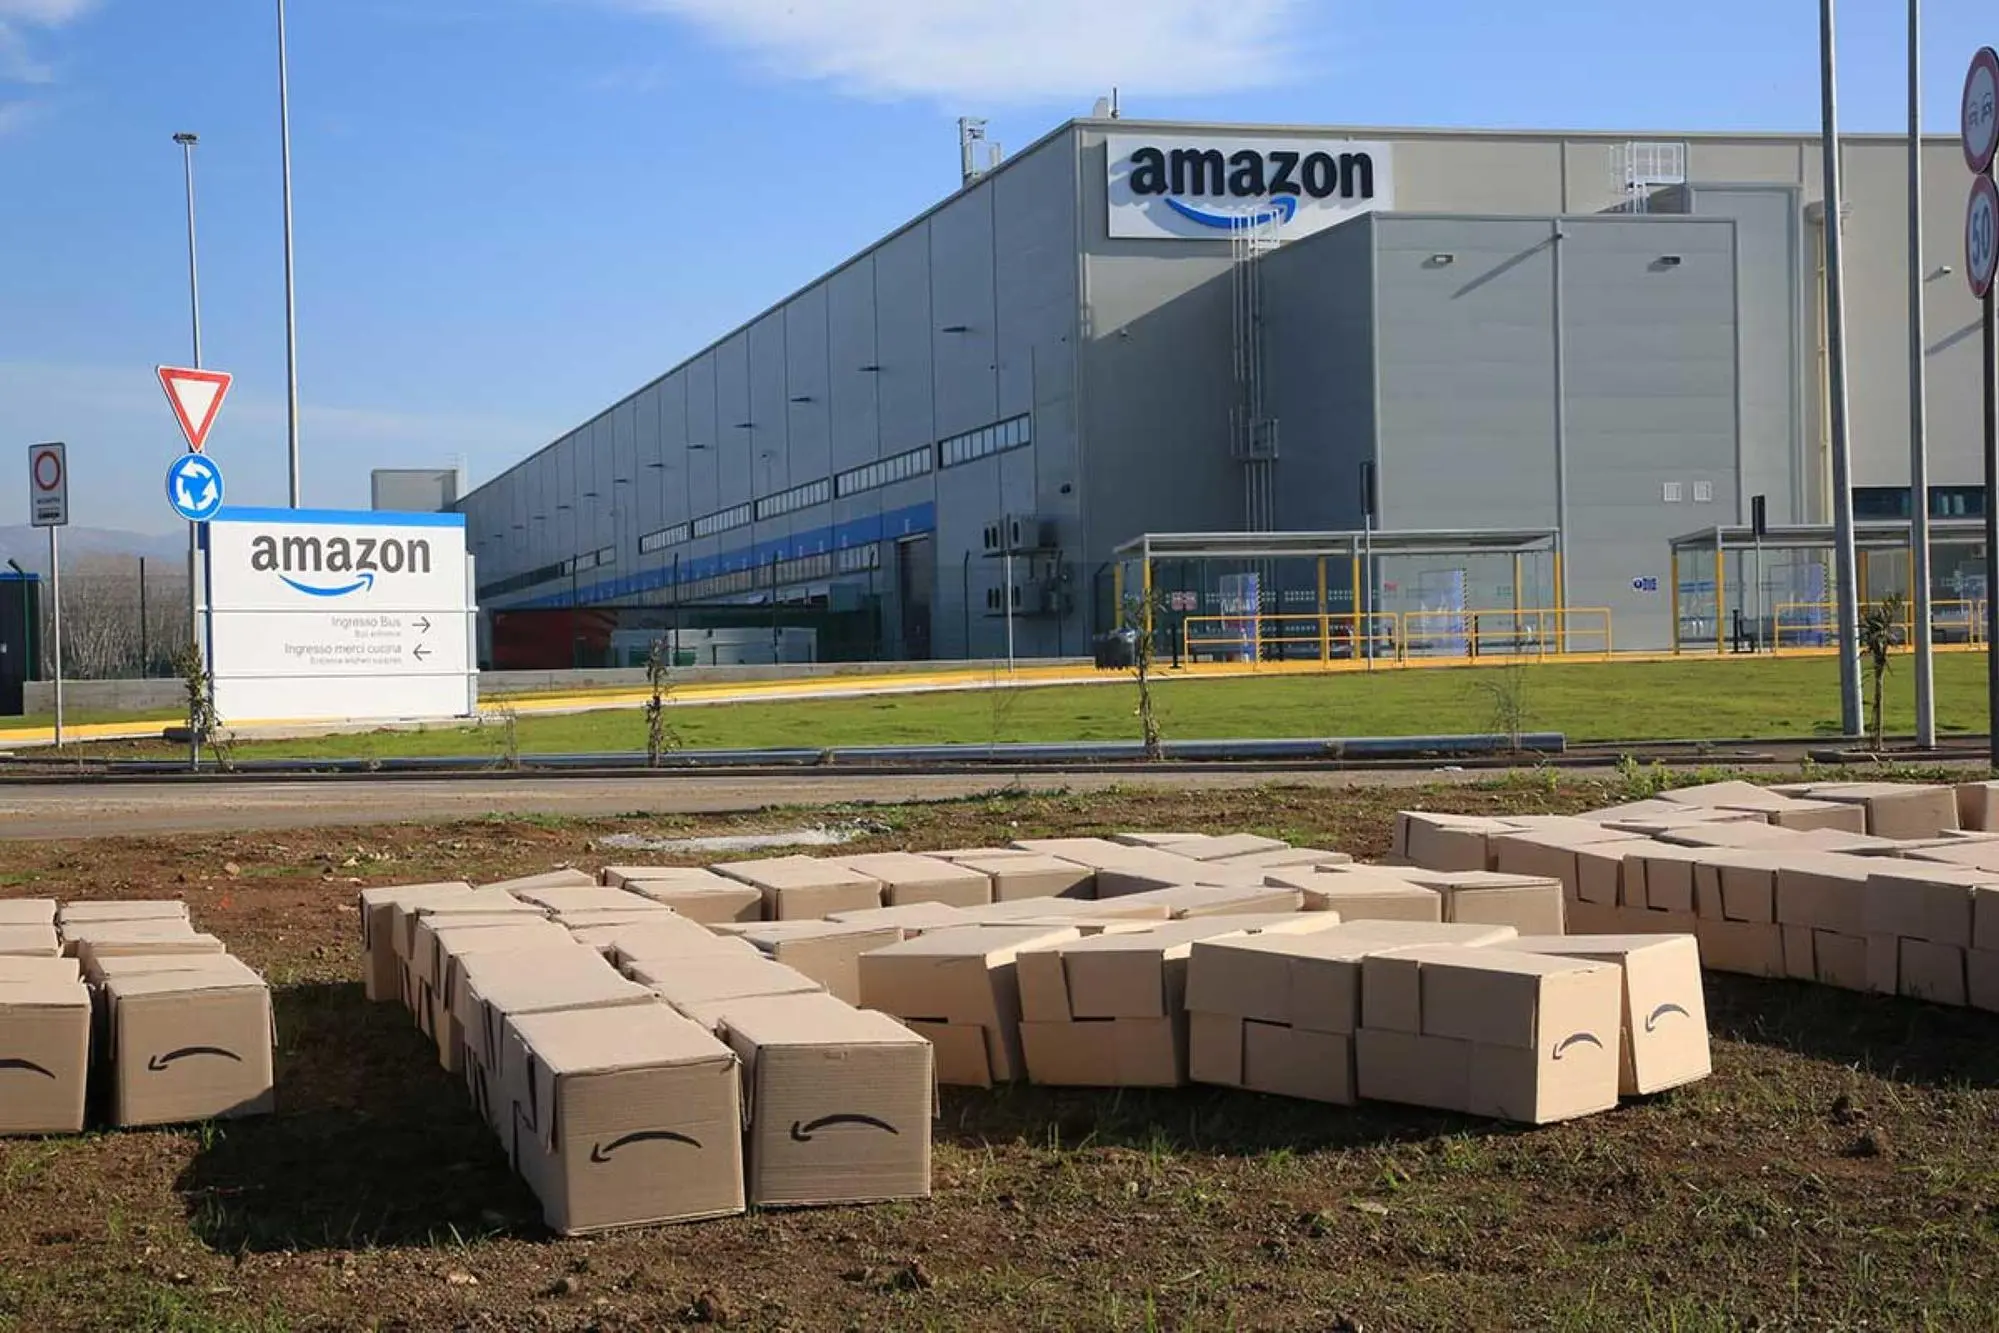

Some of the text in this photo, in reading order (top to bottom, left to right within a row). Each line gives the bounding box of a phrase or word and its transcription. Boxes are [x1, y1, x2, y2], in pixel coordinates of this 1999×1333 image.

[1130, 146, 1373, 198] amazon
[1972, 204, 1991, 266] 50
[251, 535, 430, 573] amazon
[331, 616, 402, 630] Ingresso Bus
[284, 643, 333, 656] Ingresso
